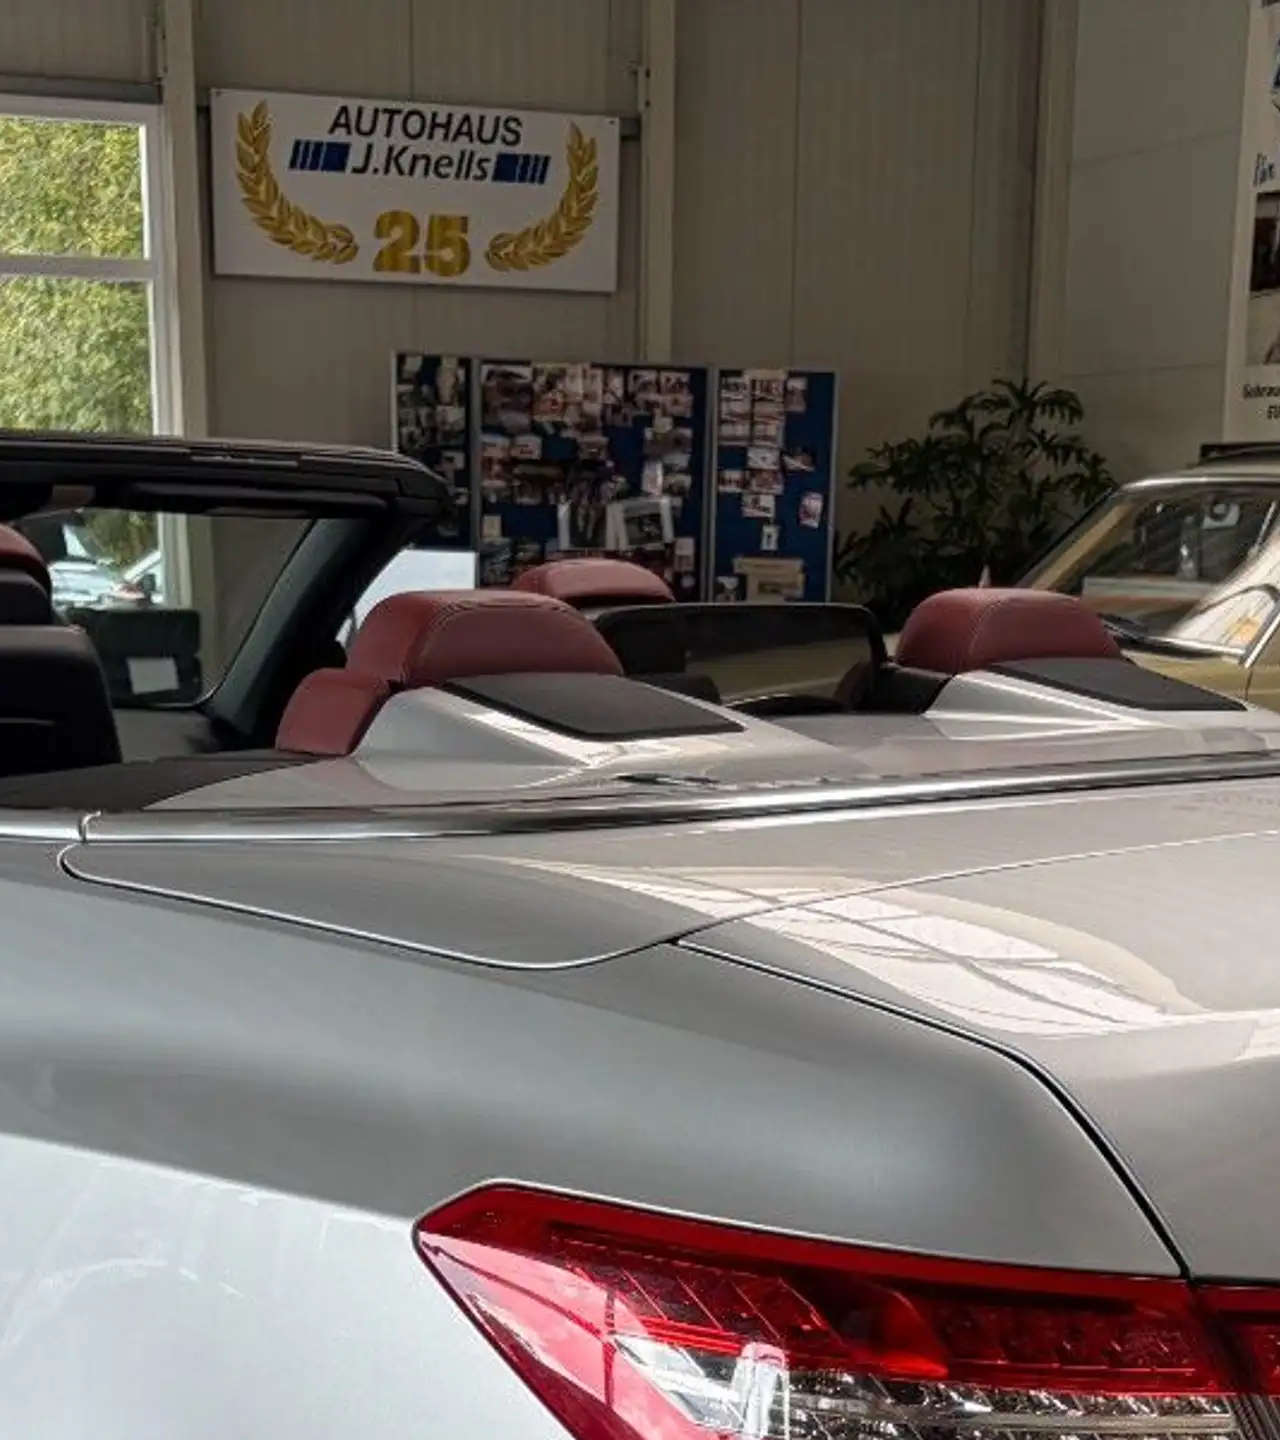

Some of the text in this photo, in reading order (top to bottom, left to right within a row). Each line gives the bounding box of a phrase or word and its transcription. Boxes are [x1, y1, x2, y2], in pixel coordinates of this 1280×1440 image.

[328, 105, 523, 146] AUTOHAUS
[351, 145, 490, 182] J.Knells
[372, 210, 471, 277] 25
